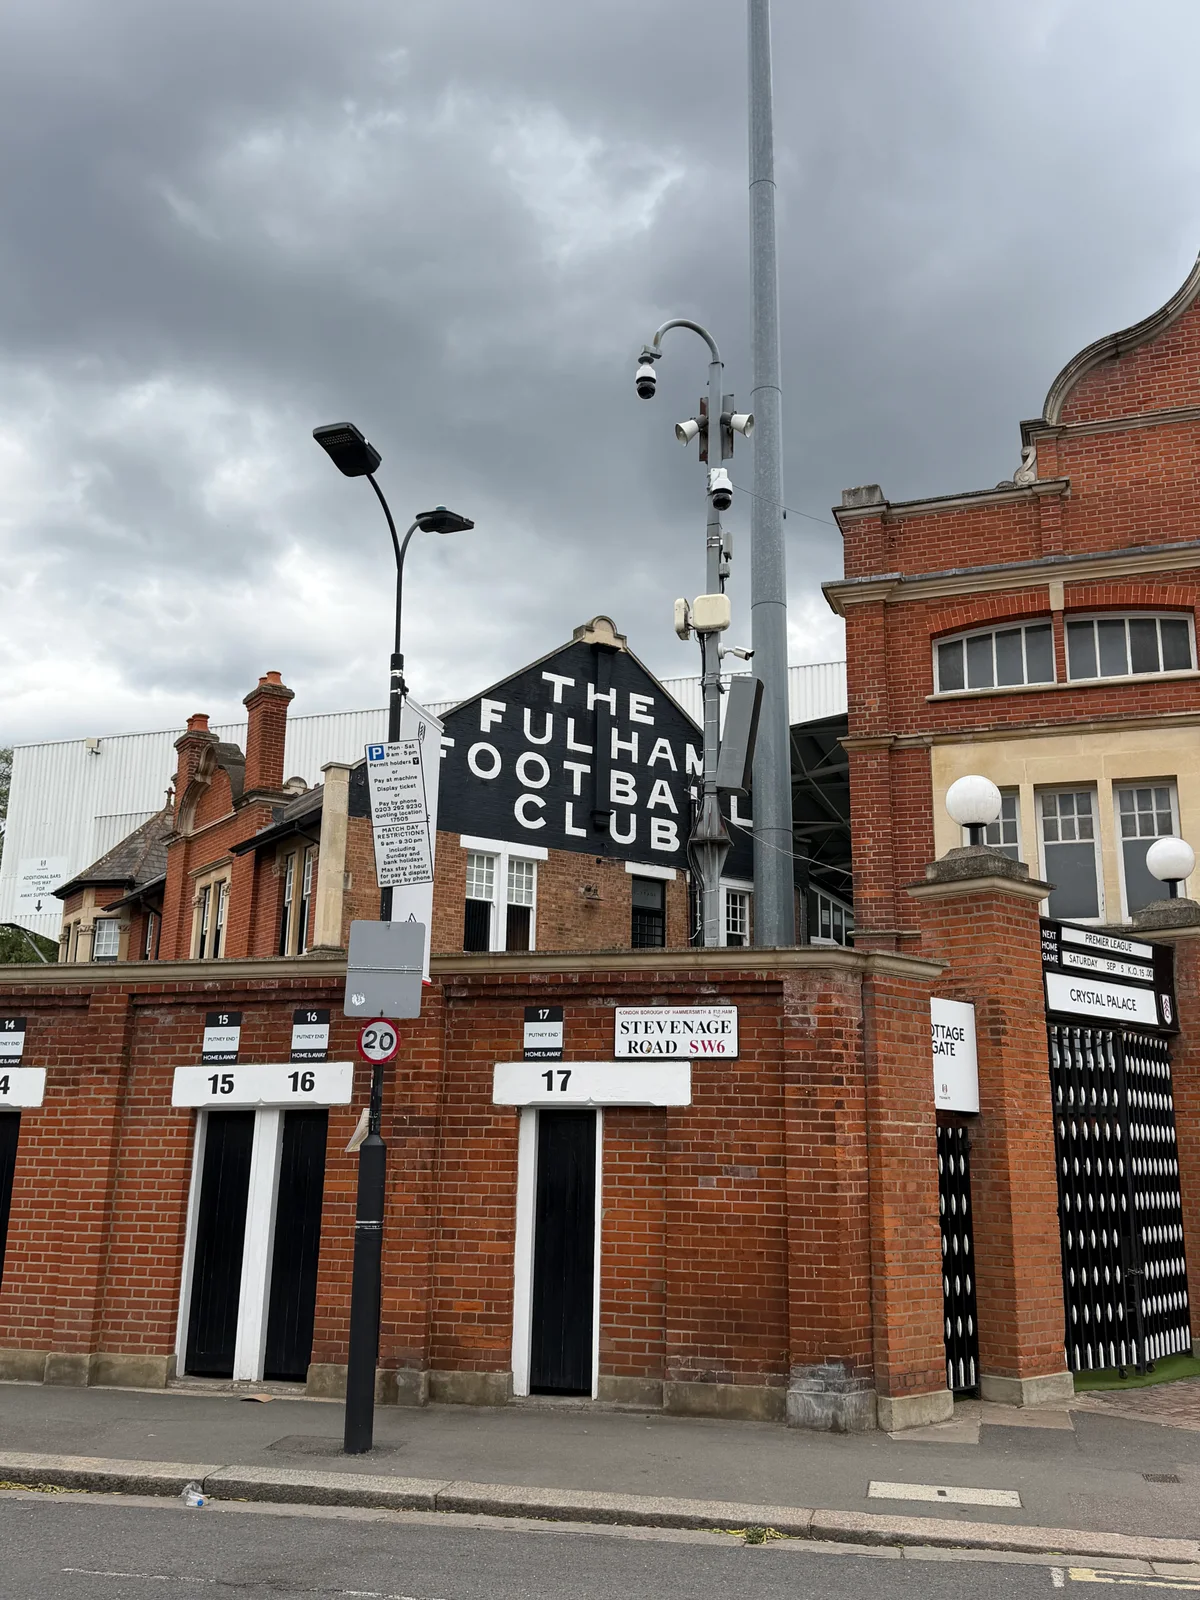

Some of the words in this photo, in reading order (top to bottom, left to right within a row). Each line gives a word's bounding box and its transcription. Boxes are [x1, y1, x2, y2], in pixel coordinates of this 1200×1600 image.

[542, 671, 654, 725] THE
[514, 793, 680, 852] CLUB
[378, 830, 424, 839] RESTRICTIONS
[1042, 930, 1056, 940] NEXT
[1042, 941, 1058, 951] HOME
[1085, 934, 1109, 947] PREMIER
[1110, 939, 1132, 952] LEAGUE
[1042, 953, 1058, 963] GAME
[1069, 954, 1098, 967] SATURDAY
[1107, 962, 1116, 971] SEP
[1121, 964, 1124, 972] 5
[1070, 988, 1105, 1006] CRYSTAL
[1107, 995, 1137, 1011] PALACE
[218, 1015, 229, 1024] 15
[307, 1012, 318, 1022] 16
[538, 1009, 549, 1020] 17
[5, 1020, 15, 1029] 14
[621, 1020, 731, 1034] STEVENAGE
[364, 1030, 394, 1051] 20
[628, 1040, 677, 1054] ROAD
[689, 1040, 725, 1054] SW6
[932, 1040, 955, 1056] GATE
[208, 1074, 234, 1094] 15
[288, 1071, 315, 1092] 16
[542, 1070, 571, 1091] 17
